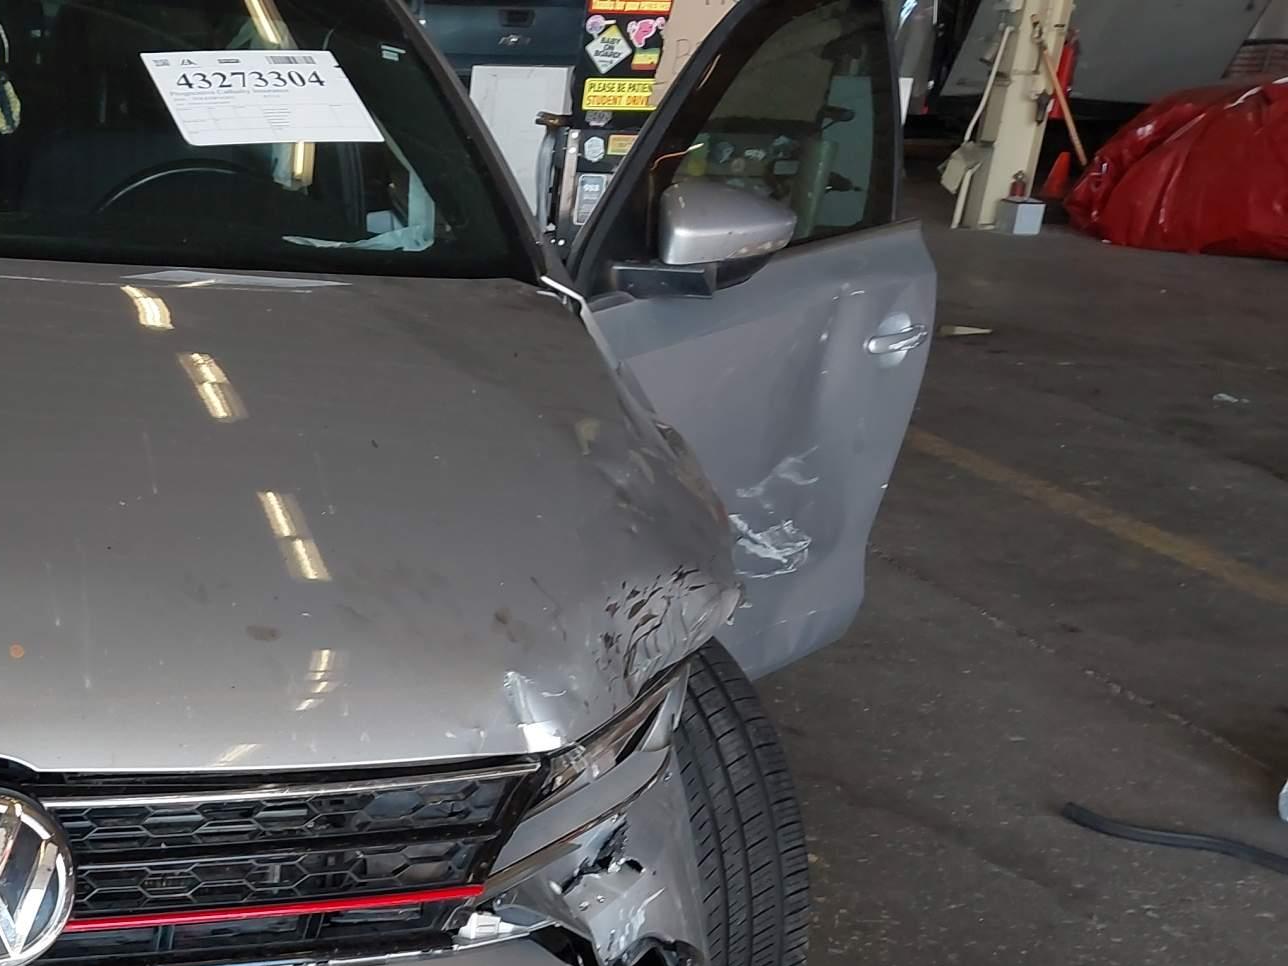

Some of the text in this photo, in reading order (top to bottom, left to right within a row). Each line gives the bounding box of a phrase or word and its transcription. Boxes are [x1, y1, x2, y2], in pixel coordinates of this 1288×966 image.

[176, 70, 325, 89] 43273304
[588, 82, 653, 93] PLEASE BE PATIEN
[585, 95, 649, 107] STUDENT DRIV
